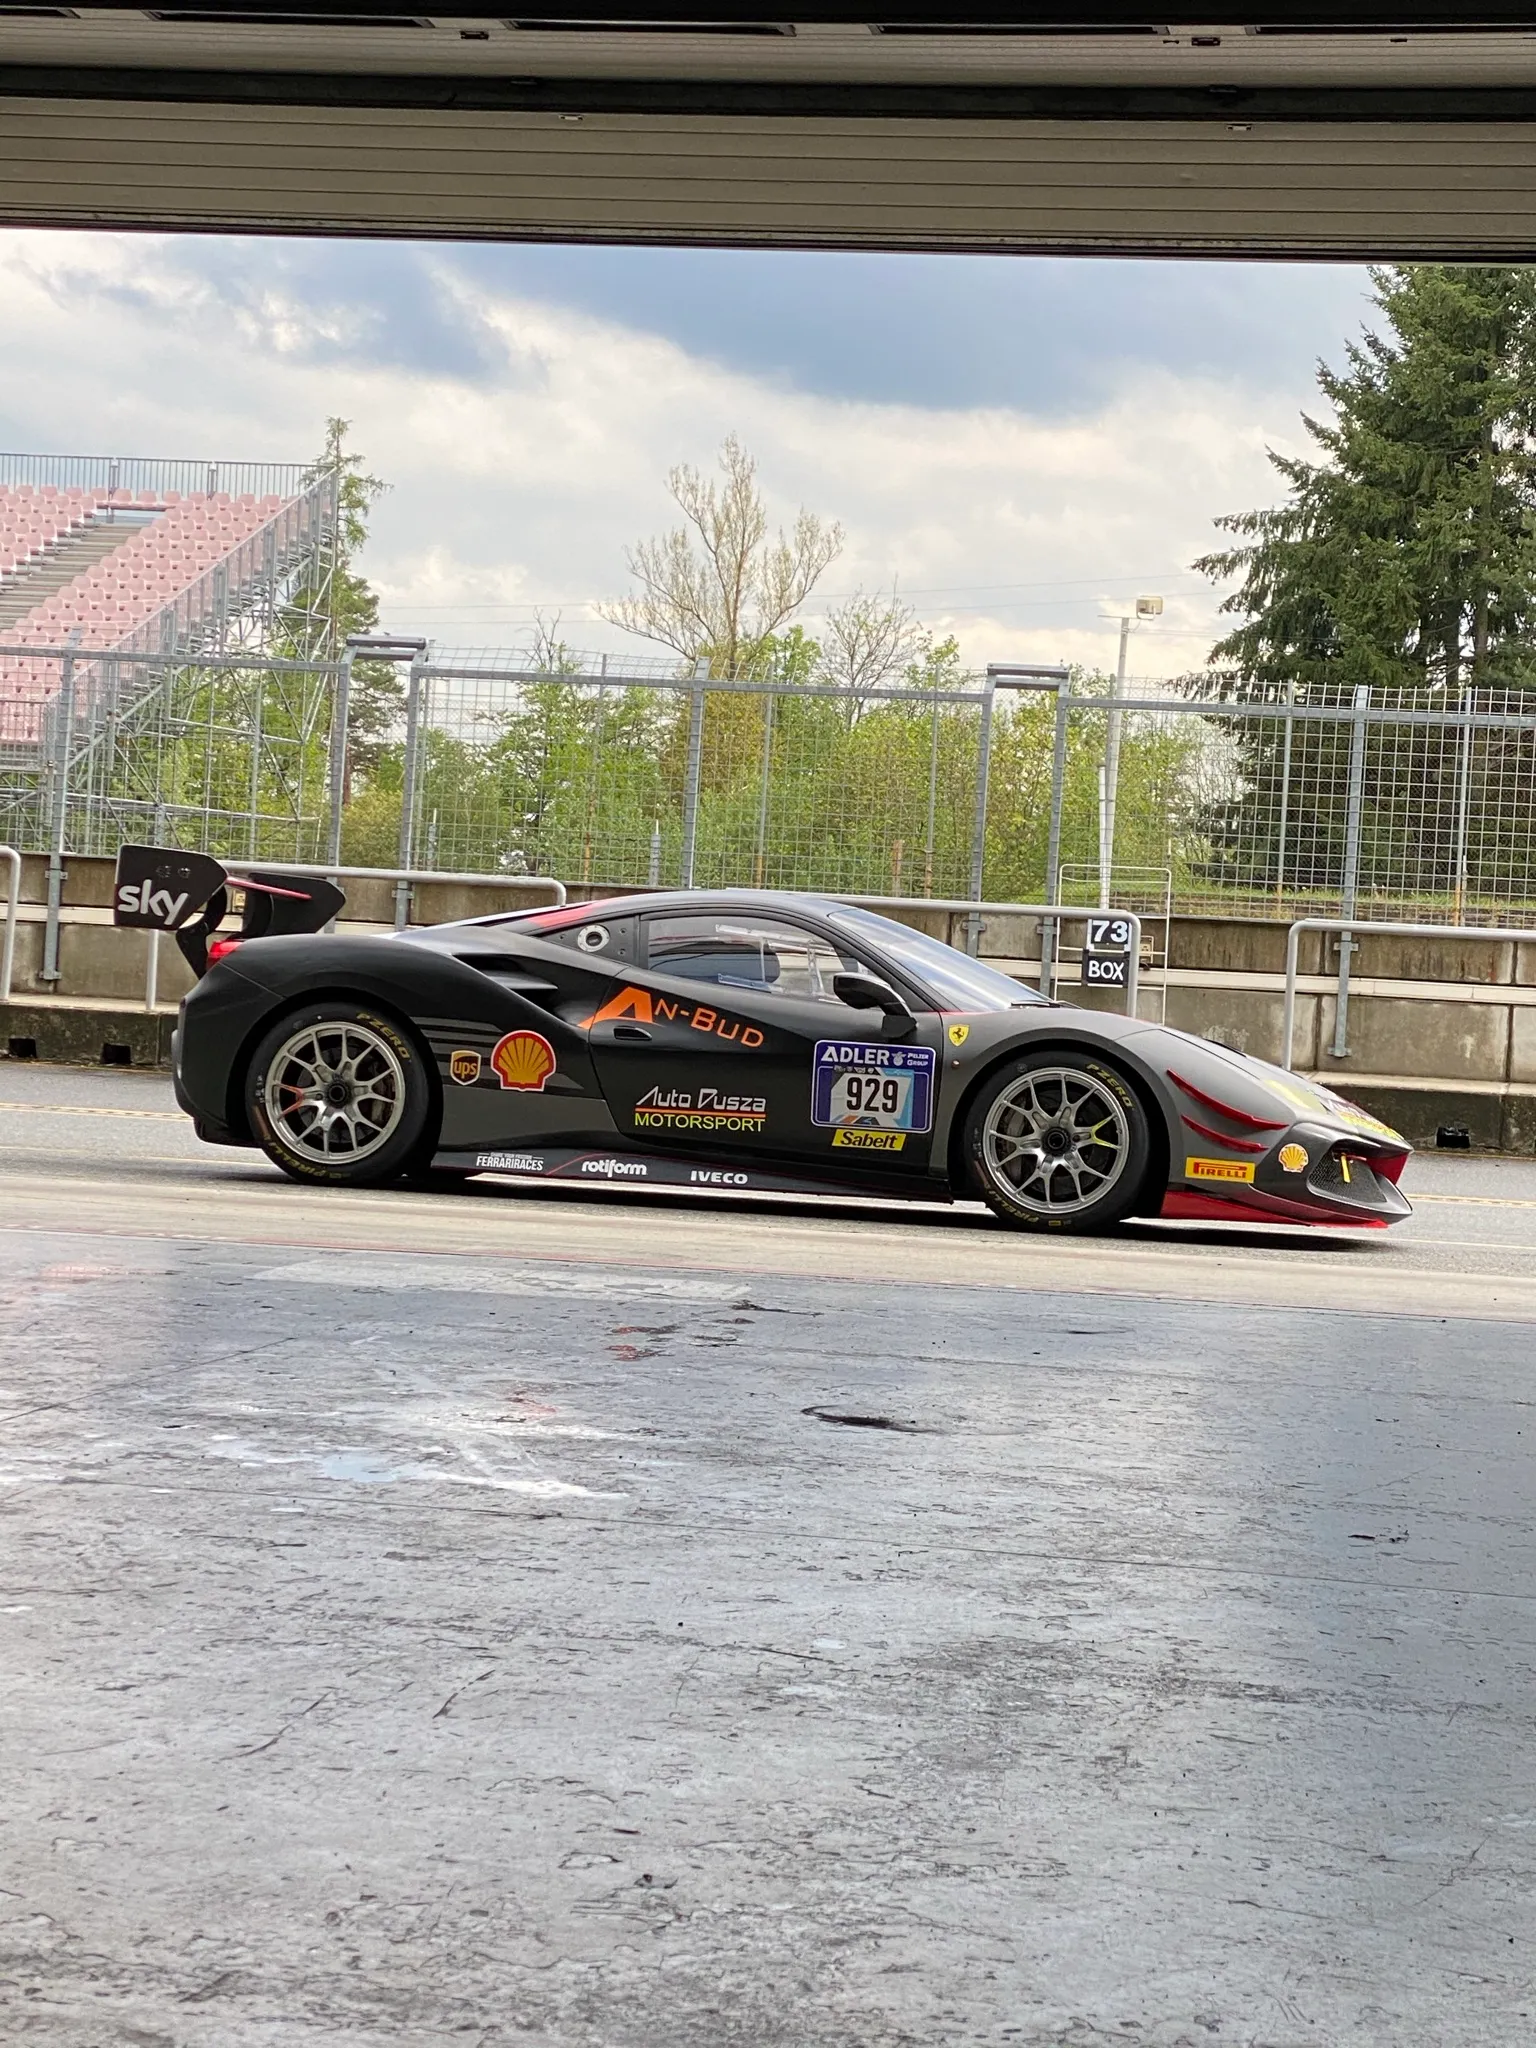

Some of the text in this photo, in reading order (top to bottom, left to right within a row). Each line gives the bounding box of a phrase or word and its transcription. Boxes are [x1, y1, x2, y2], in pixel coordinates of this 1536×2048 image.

[118, 879, 189, 925] sky
[1092, 920, 1128, 943] 73
[1088, 960, 1125, 981] BOX
[821, 1046, 890, 1066] ADLER
[453, 1062, 477, 1079] ups
[636, 1086, 692, 1108] Auto
[846, 1077, 899, 1113] 929
[634, 1113, 766, 1132] MOTORSPORT
[840, 1131, 898, 1149] Sabelt
[476, 1155, 544, 1171] FERRARIRACES
[581, 1159, 648, 1178] rotiform
[1193, 1161, 1248, 1179] PIRELLI
[690, 1170, 748, 1184] IVECO
